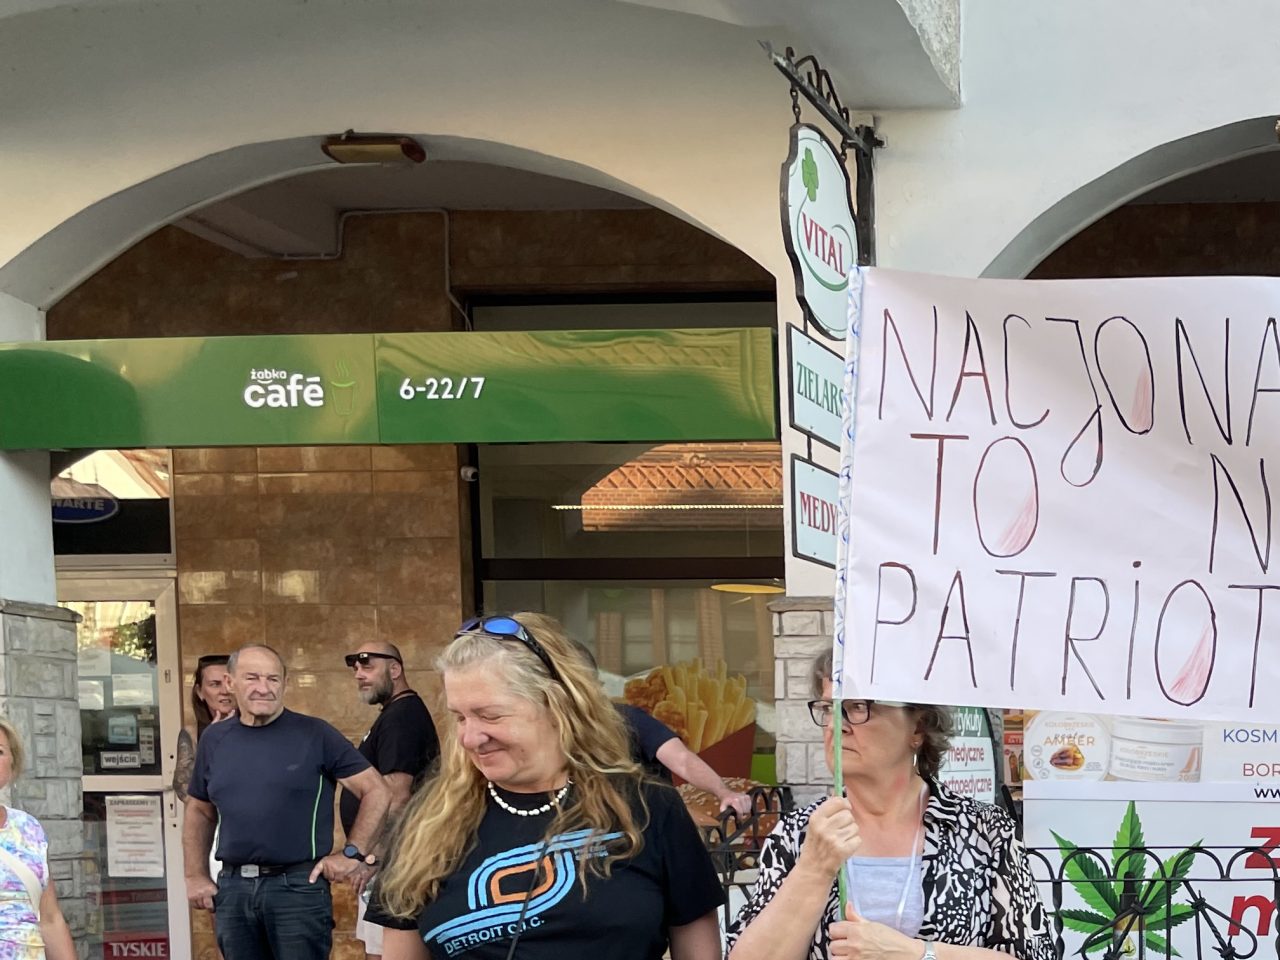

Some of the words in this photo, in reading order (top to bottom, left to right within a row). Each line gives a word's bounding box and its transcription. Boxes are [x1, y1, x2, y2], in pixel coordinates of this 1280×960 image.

[802, 211, 846, 278] VITAL
[251, 368, 287, 380] żabka
[244, 374, 324, 408] café
[399, 377, 486, 399] 6-22/7
[911, 433, 1039, 557] TO
[104, 753, 137, 765] wejście
[110, 942, 167, 957] TYSKIE
[443, 925, 504, 955] DETROIT
